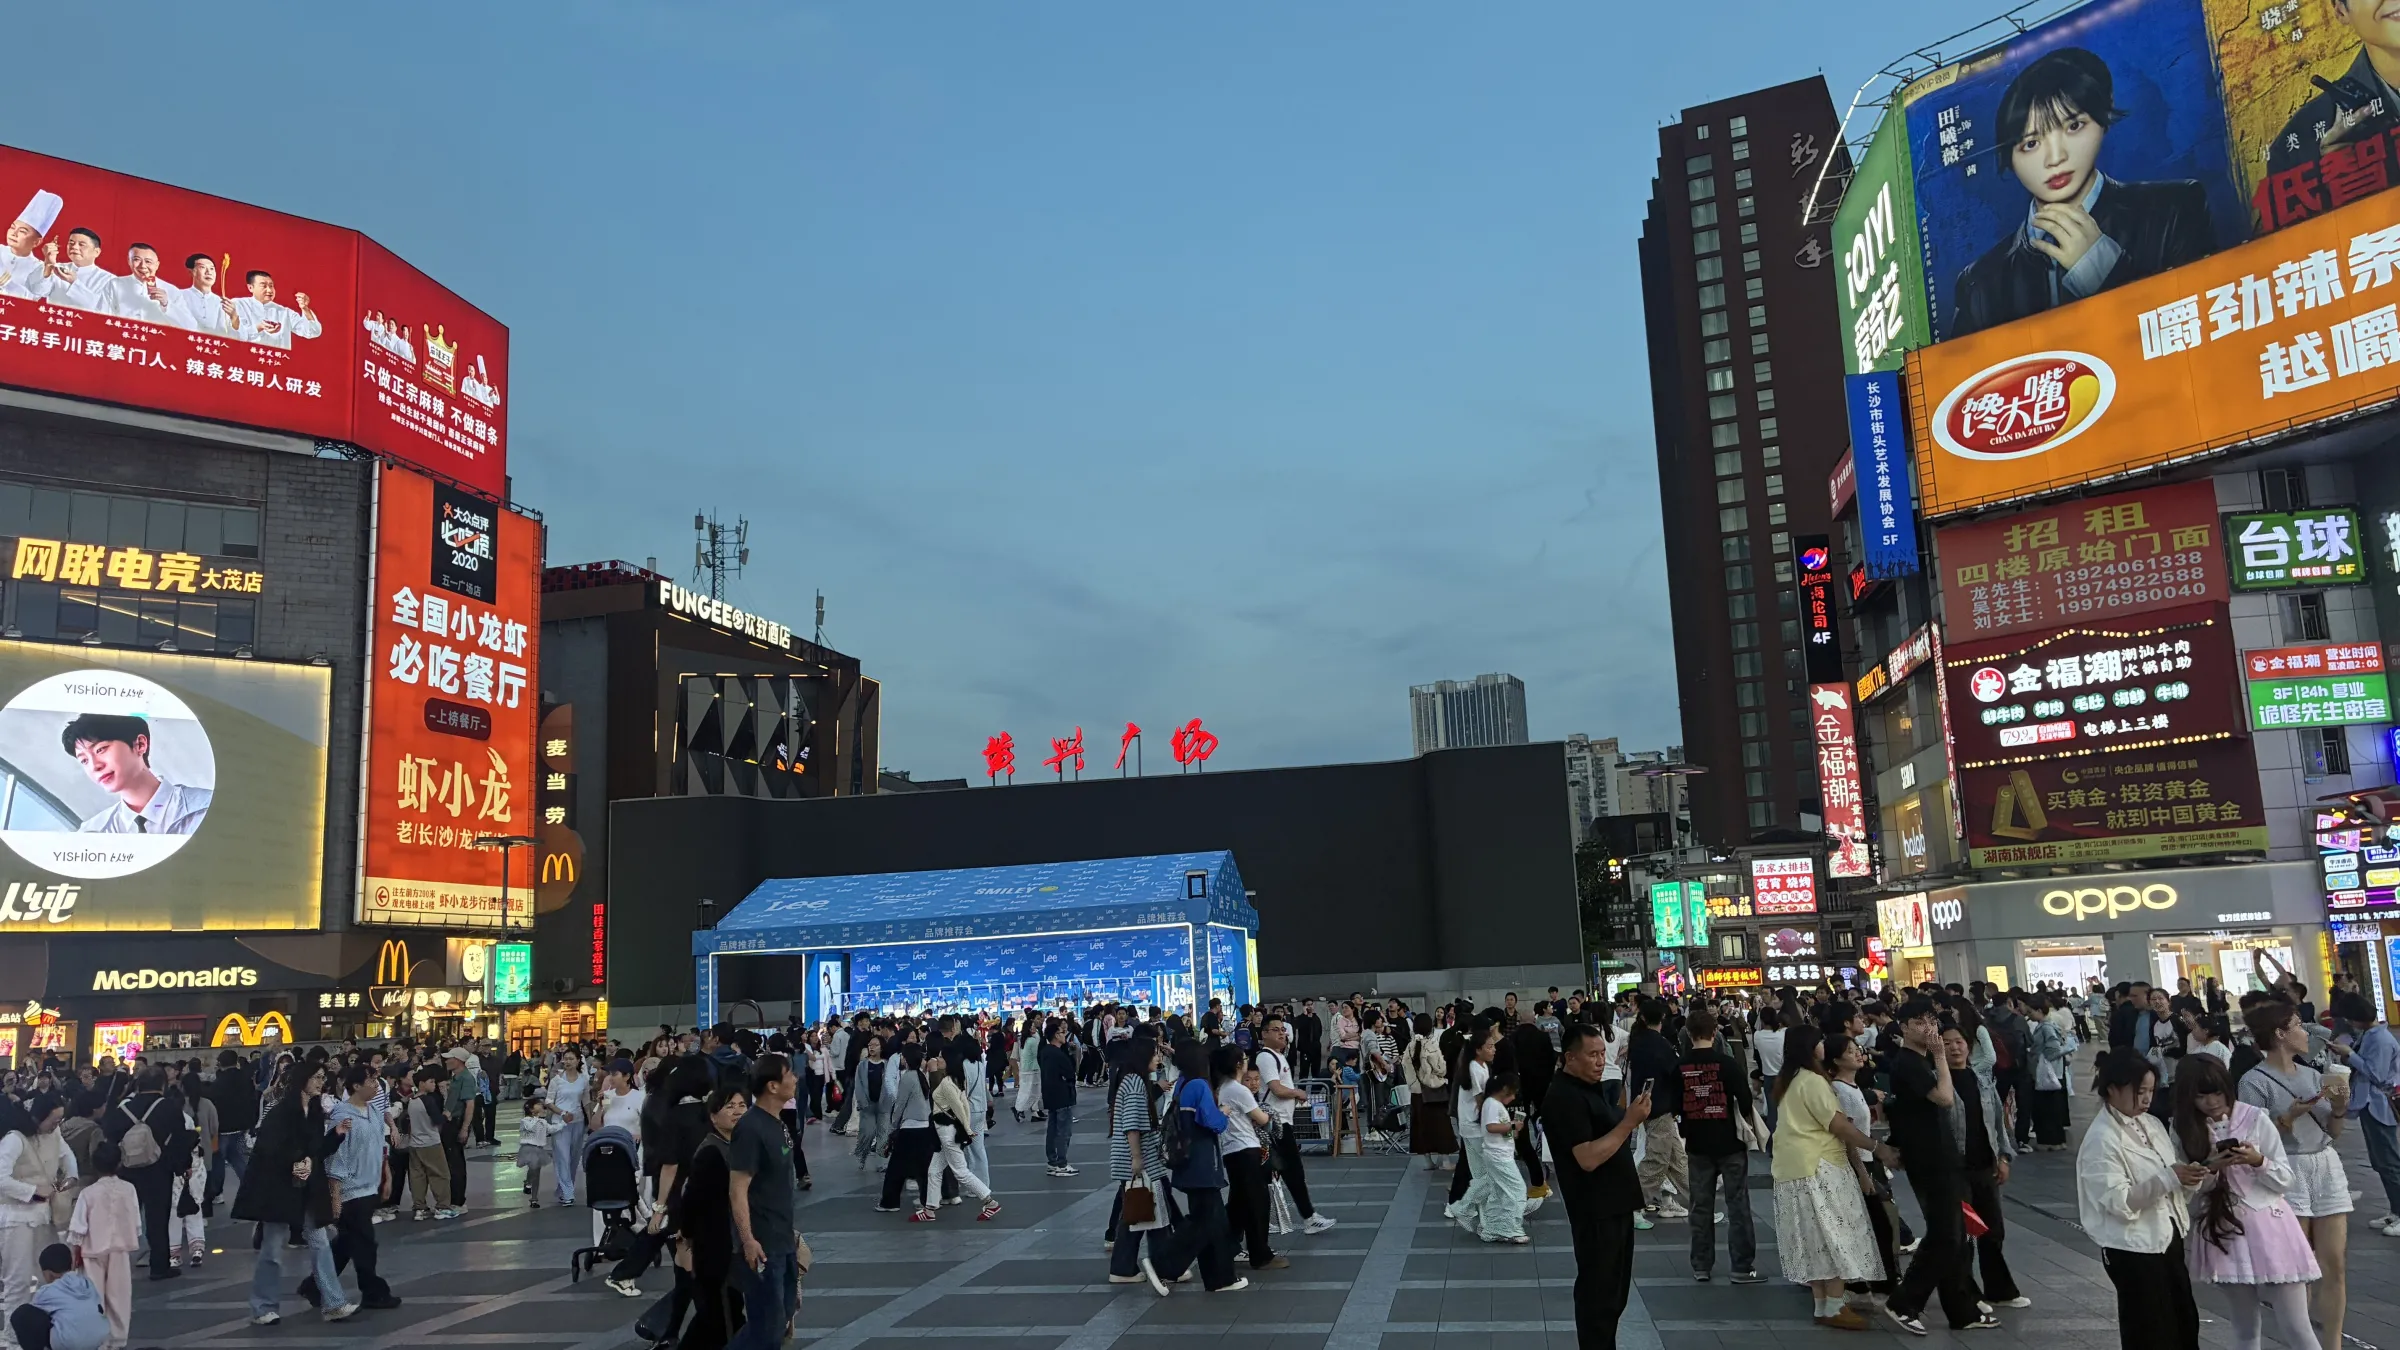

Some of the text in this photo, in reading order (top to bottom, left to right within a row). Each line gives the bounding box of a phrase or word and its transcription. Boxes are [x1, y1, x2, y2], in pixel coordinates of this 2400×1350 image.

[2252, 126, 2400, 232] 低智
[2137, 223, 2400, 361] 嚼劲辣条
[363, 359, 498, 447] 只做正宗麻辣 不做甜条
[1989, 423, 2056, 446] CHAN DA ZUI BA
[1866, 381, 1896, 529] 长沙市街头艺术发展协会
[453, 506, 490, 531] 大众点评
[2003, 501, 2151, 553] 招租
[440, 519, 490, 560] 必吃榜
[1882, 534, 1899, 546] 5F
[2239, 515, 2355, 568] 台球
[12, 537, 264, 593] 网联电竞 大茂店
[451, 550, 479, 572] 2020
[1956, 524, 2211, 588] 四楼原始门面
[2053, 551, 2203, 585] 13924061338
[2335, 563, 2356, 576] 5F
[442, 574, 481, 597] 五一广场店
[2054, 567, 2205, 600] 13974922588
[659, 579, 733, 629] FUNGEE
[1810, 586, 1828, 628] 海伦司
[2056, 582, 2207, 616] 19976980040
[392, 586, 528, 659] 全国小龙虾
[744, 612, 791, 650] 欢致酒店
[1812, 631, 1832, 645] 4F
[2121, 639, 2191, 663] 潮汕牛肉
[2269, 654, 2322, 671] 金福潮
[2325, 646, 2378, 661] 营业时间
[389, 633, 528, 709] 必吃餐厅
[2007, 650, 2123, 696] 金福潮
[2124, 656, 2193, 679] 火锅自助
[1981, 681, 2190, 726] 鲜牛肉 烤肉 毛肚 海鲜 牛排
[2272, 682, 2367, 700] 3F 24h 营业
[2259, 699, 2387, 726] 诡怪先生密室
[2083, 713, 2170, 738] 电梯上三楼
[982, 718, 1219, 778] 黄兴广场
[1843, 735, 1857, 772] 鲜牛肉
[1815, 714, 1850, 809] 金福潮
[397, 748, 513, 824] 虾小龙
[545, 739, 567, 825] 麦当劳
[2047, 778, 2211, 811] 买黄金·投资黄金
[1848, 779, 1866, 841] 无限量自助
[974, 885, 1037, 895] SMILEY
[1756, 875, 1812, 890] 夜宵 烧烤
[764, 899, 830, 912] Lee
[1759, 890, 1812, 904] 家常口味菜
[1137, 911, 1187, 924] 品牌推荐会
[924, 925, 974, 938] 品牌推荐会
[719, 939, 766, 951] 品牌推荐会
[1090, 942, 1105, 950] Lee
[1132, 949, 1148, 958] Lee
[1217, 945, 1232, 953] Lee
[867, 964, 881, 973] Lee
[955, 959, 968, 968] Lee
[1043, 954, 1058, 963] Lee
[1090, 962, 1105, 971] Lee
[92, 966, 258, 991] McDonald's
[913, 972, 927, 980] Lee
[1001, 967, 1015, 976] Lee
[319, 993, 361, 1009] 麦当劳
